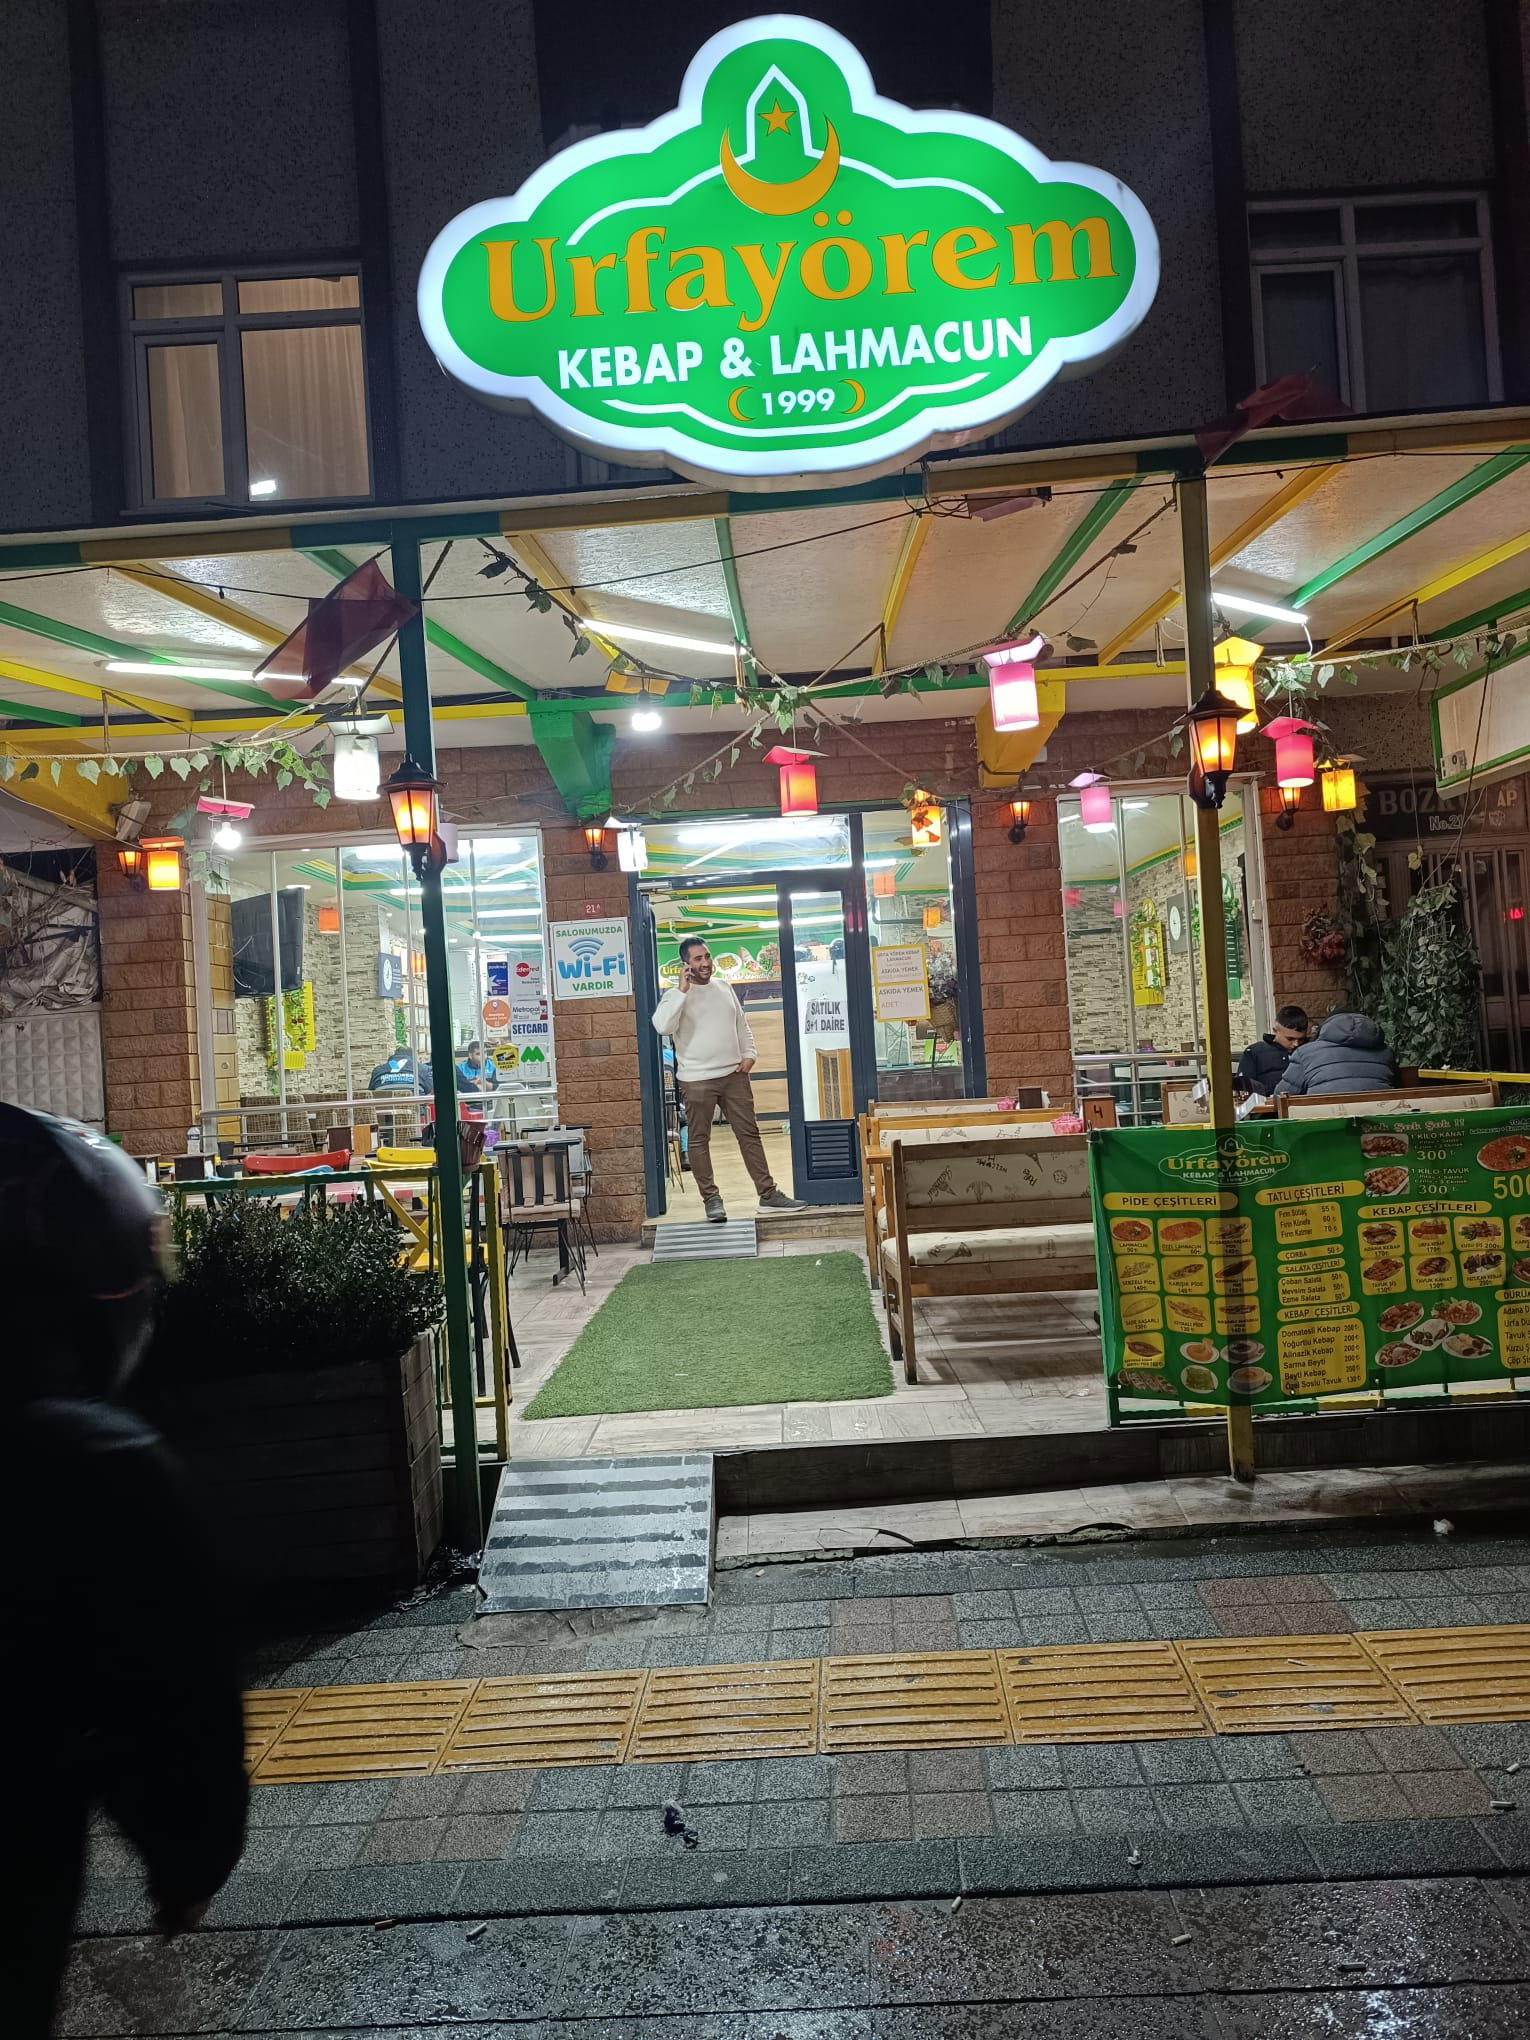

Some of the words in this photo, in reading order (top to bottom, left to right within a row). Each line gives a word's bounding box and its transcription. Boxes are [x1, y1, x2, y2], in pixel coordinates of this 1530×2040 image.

[481, 210, 1119, 331] Urfayörem
[558, 340, 703, 390] KEBAP
[720, 337, 754, 378] &
[770, 316, 1033, 376] LAHMACUN
[761, 387, 836, 415] 1999
[556, 926, 623, 938] SALONUMUZDA
[558, 952, 626, 980] Wi-Fi
[572, 981, 614, 992] VARDIR
[811, 1002, 841, 1015] SATILIK
[512, 1023, 548, 1035] SETCARD
[806, 1019, 818, 1031] 3+1
[821, 1016, 845, 1031] DAİRE
[1093, 1104, 1103, 1118] 4
[1439, 1130, 1465, 1138] KANAT
[1417, 1150, 1447, 1160] 300
[1168, 1154, 1288, 1172] Urfayörem
[1228, 1167, 1275, 1178] LAHMACUN
[1267, 1192, 1292, 1202] TATLI
[1294, 1183, 1345, 1202] ÇEŞİTLERİ
[1419, 1184, 1448, 1194] 300
[1122, 1195, 1149, 1206] PİDE
[1153, 1195, 1217, 1208] ÇEŞİTLERİ
[1373, 1205, 1411, 1216] KEBAP
[1415, 1201, 1477, 1216] ÇEŞİTLERİ
[1285, 1251, 1307, 1259] ÇORBA
[1286, 1265, 1311, 1273] SALATA
[1284, 1310, 1309, 1319] KEBAP
[1315, 1304, 1353, 1319] ÇEŞİTLERİ
[1504, 1320, 1520, 1328] Urfa
[1282, 1327, 1316, 1338] Domatesli
[1317, 1325, 1341, 1333] Kebap
[1505, 1332, 1526, 1340] Tavuk
[1313, 1336, 1335, 1345] Kebap
[1312, 1347, 1334, 1356] Kebap
[1506, 1344, 1524, 1352] Kuzu
[1283, 1361, 1306, 1369] Sarma
[1308, 1359, 1325, 1368] Beyti
[1304, 1369, 1326, 1378] Kebap
[1322, 1377, 1342, 1385] Tavuk
